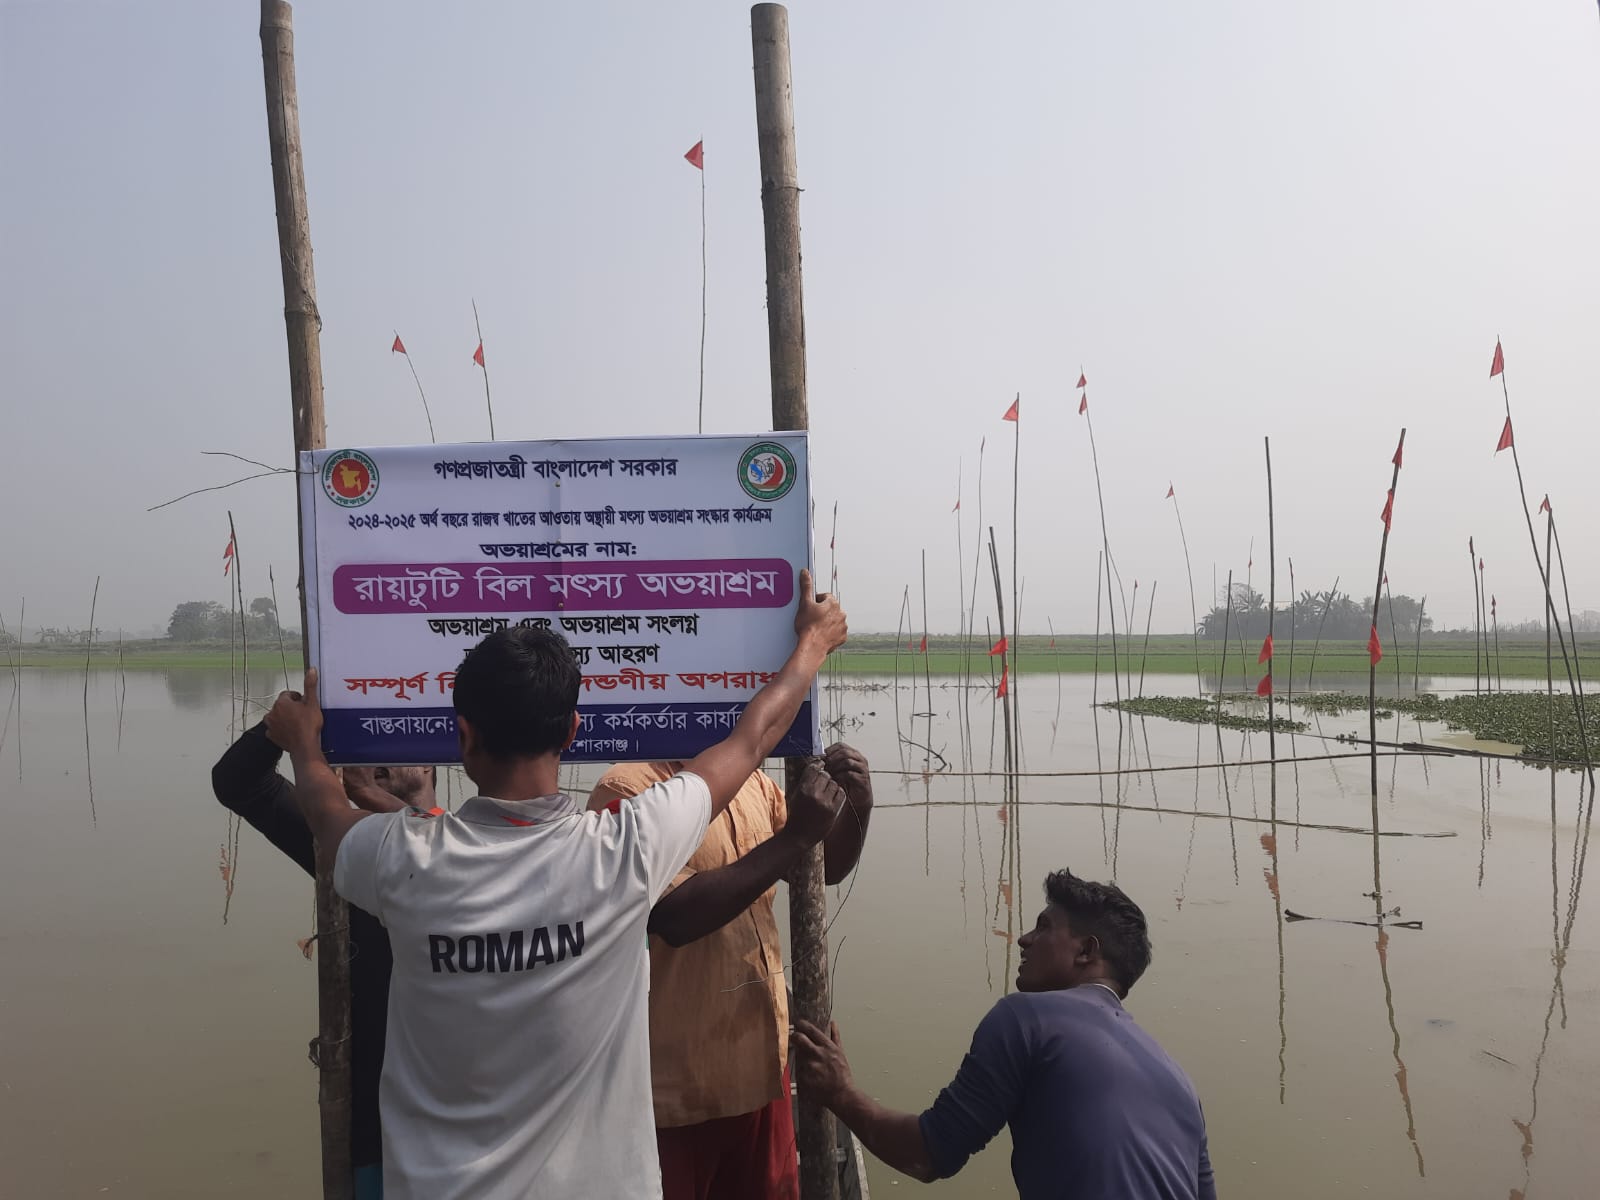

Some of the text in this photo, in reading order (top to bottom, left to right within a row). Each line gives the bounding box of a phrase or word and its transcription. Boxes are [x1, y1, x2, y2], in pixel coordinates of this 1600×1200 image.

[434, 454, 678, 480] গণপ্রজাতন্ত্রী বাংলাদেশ সরকার
[348, 513, 416, 530] ২০২৪-২০২৫
[419, 508, 439, 528] অর্থ
[441, 513, 469, 528] বছরে
[539, 509, 581, 526] আওতায়
[584, 505, 616, 529] অস্থায়ী
[618, 510, 645, 525] মৎস্য
[648, 508, 693, 525] অভয়াশ্রম
[732, 503, 772, 524] কার্যক্রম
[479, 541, 590, 559] অভয়াশ্রমের
[351, 565, 779, 610] রায়টুটি বিল মৎস্য অভয়াশ্রম
[560, 614, 641, 636] অভয়াশ্রম
[646, 613, 700, 636] সংলগ্ন
[596, 643, 660, 664] আহরণ
[343, 671, 430, 701] সম্পূর্ণ
[601, 704, 688, 731] কর্মকর্তার
[428, 920, 586, 974] ROMAN
